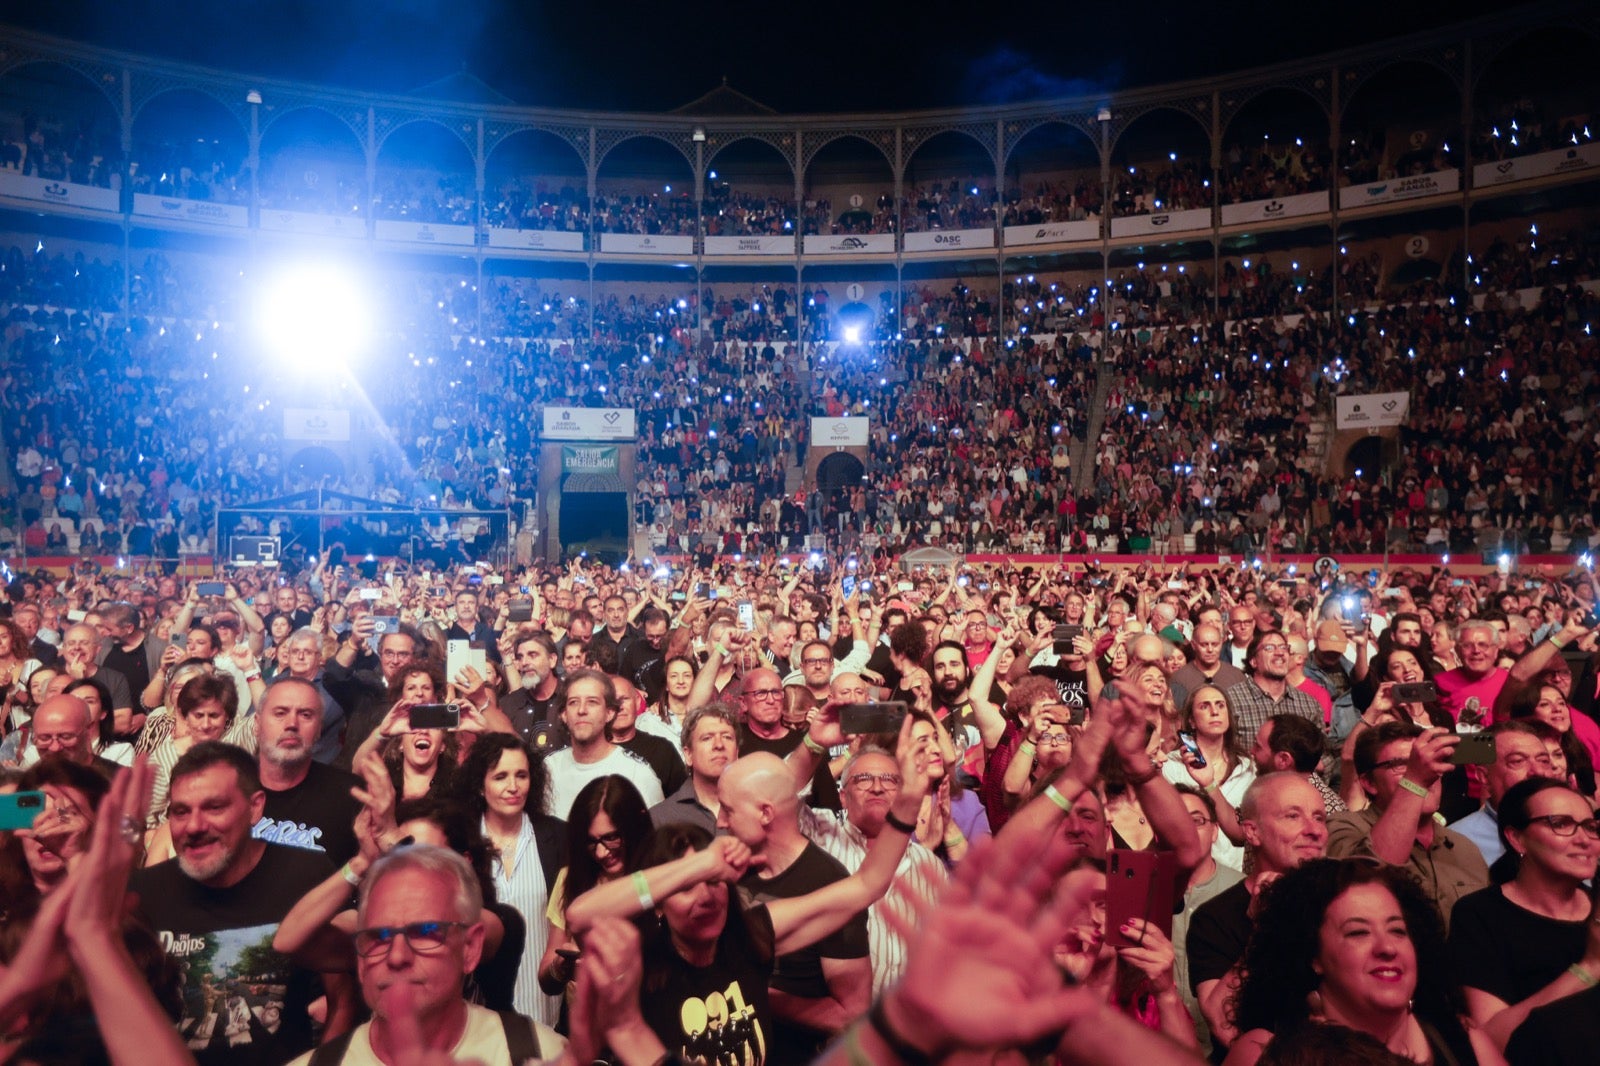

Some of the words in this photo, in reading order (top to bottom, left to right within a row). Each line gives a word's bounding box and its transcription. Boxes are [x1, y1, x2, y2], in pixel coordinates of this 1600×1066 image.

[943, 234, 961, 243] ASC
[1412, 238, 1423, 254] 2
[575, 449, 602, 458] SALIDA
[565, 458, 615, 468] EMERGENCIA
[681, 980, 756, 1036] 091
